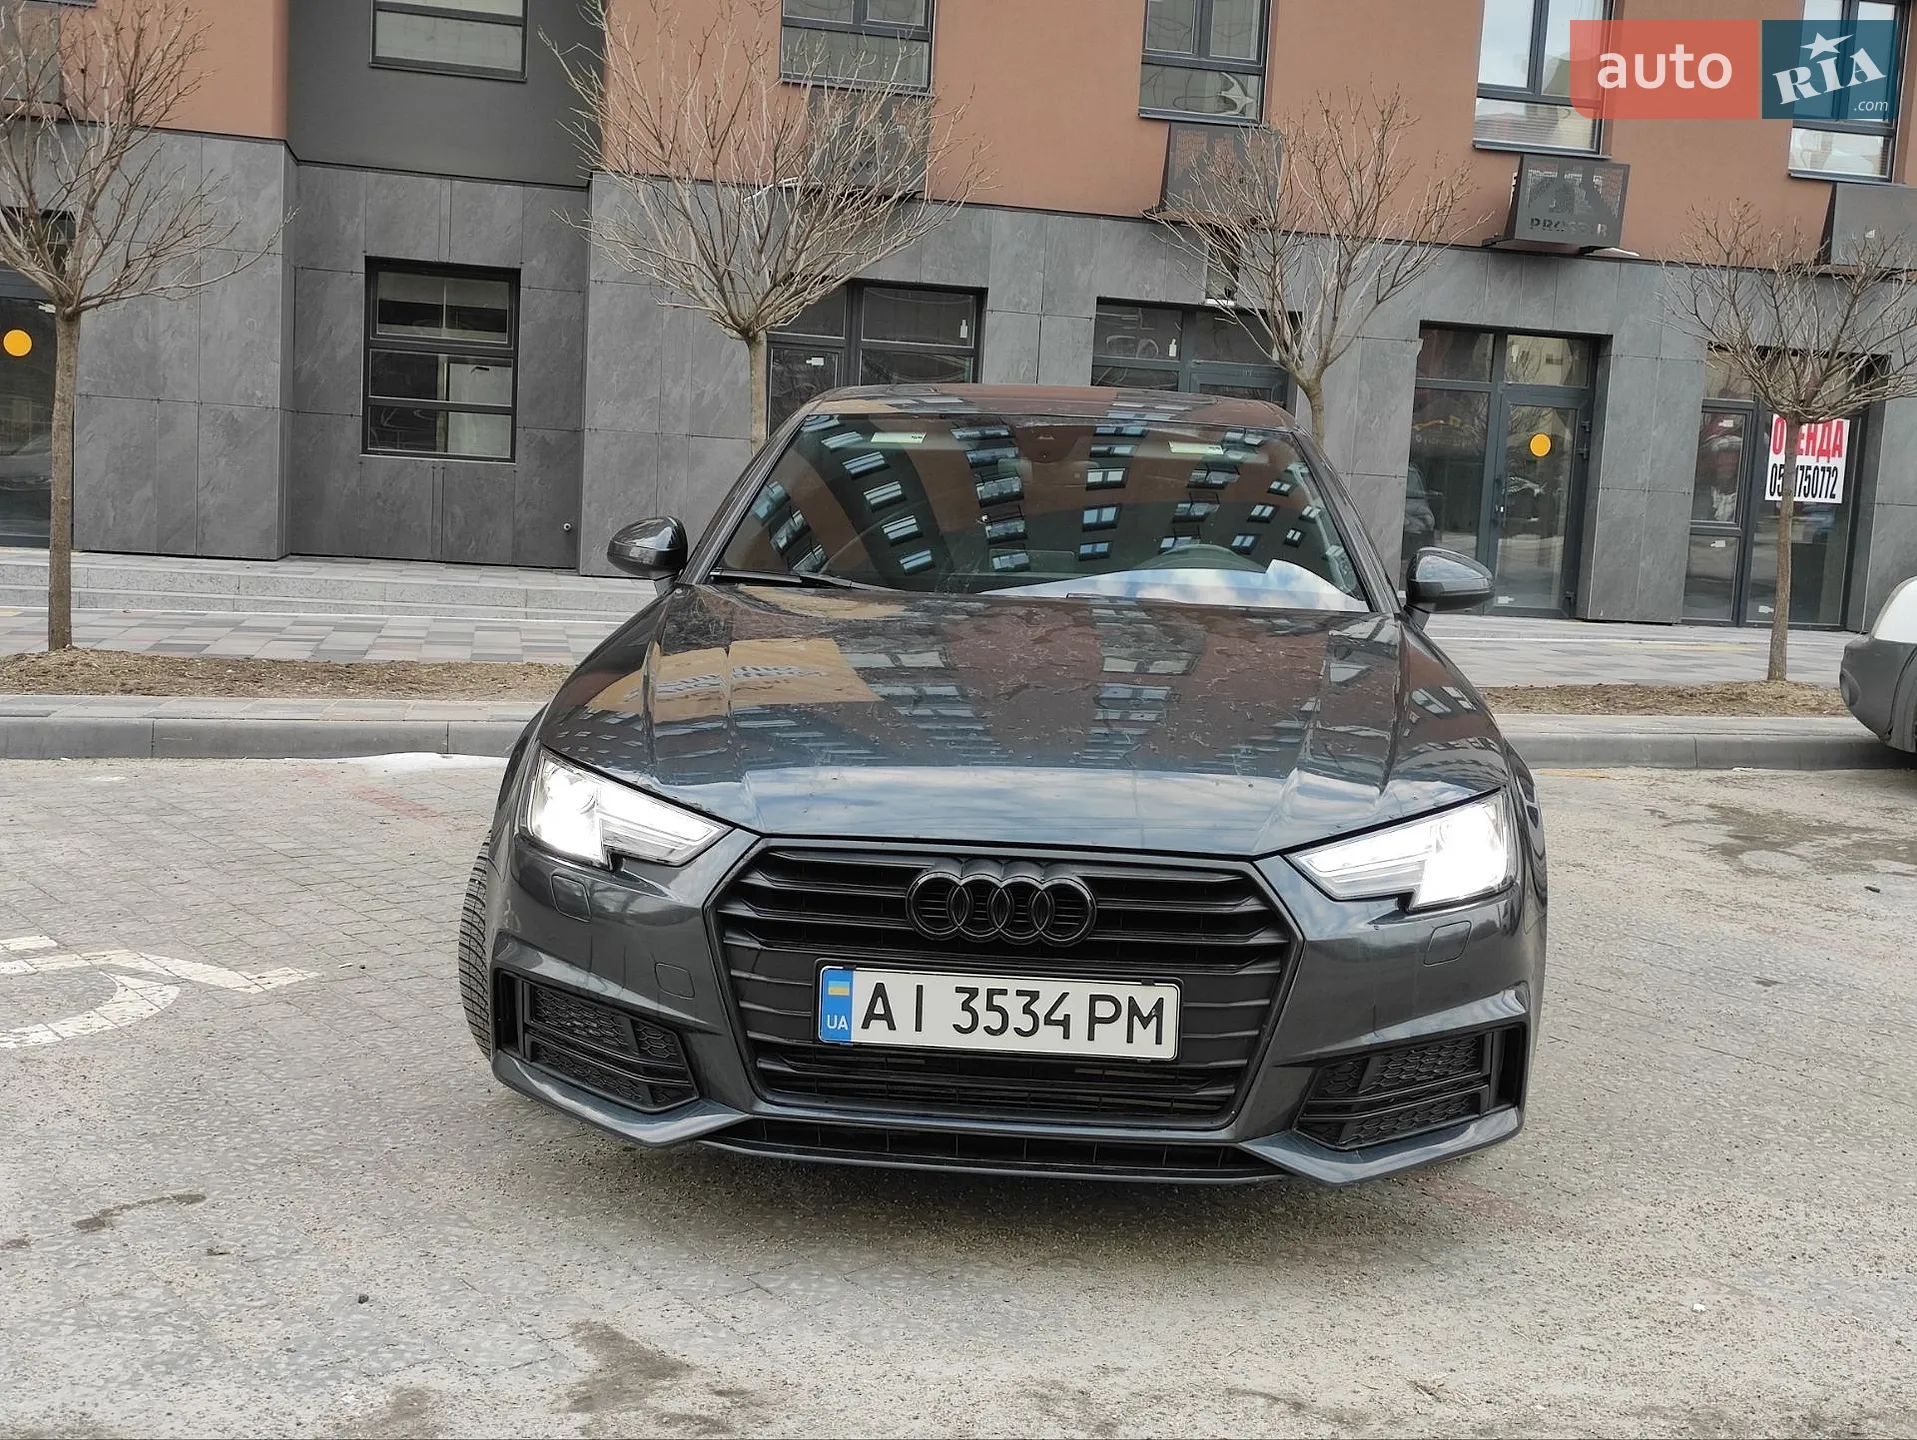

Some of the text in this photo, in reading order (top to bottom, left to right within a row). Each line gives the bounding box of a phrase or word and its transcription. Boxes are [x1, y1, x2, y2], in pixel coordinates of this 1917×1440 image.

[1772, 417, 1845, 463] ОЕНДА
[1769, 463, 1839, 499] 051750772
[827, 1014, 849, 1031] UA
[861, 982, 1165, 1045] AI 3534 PM
